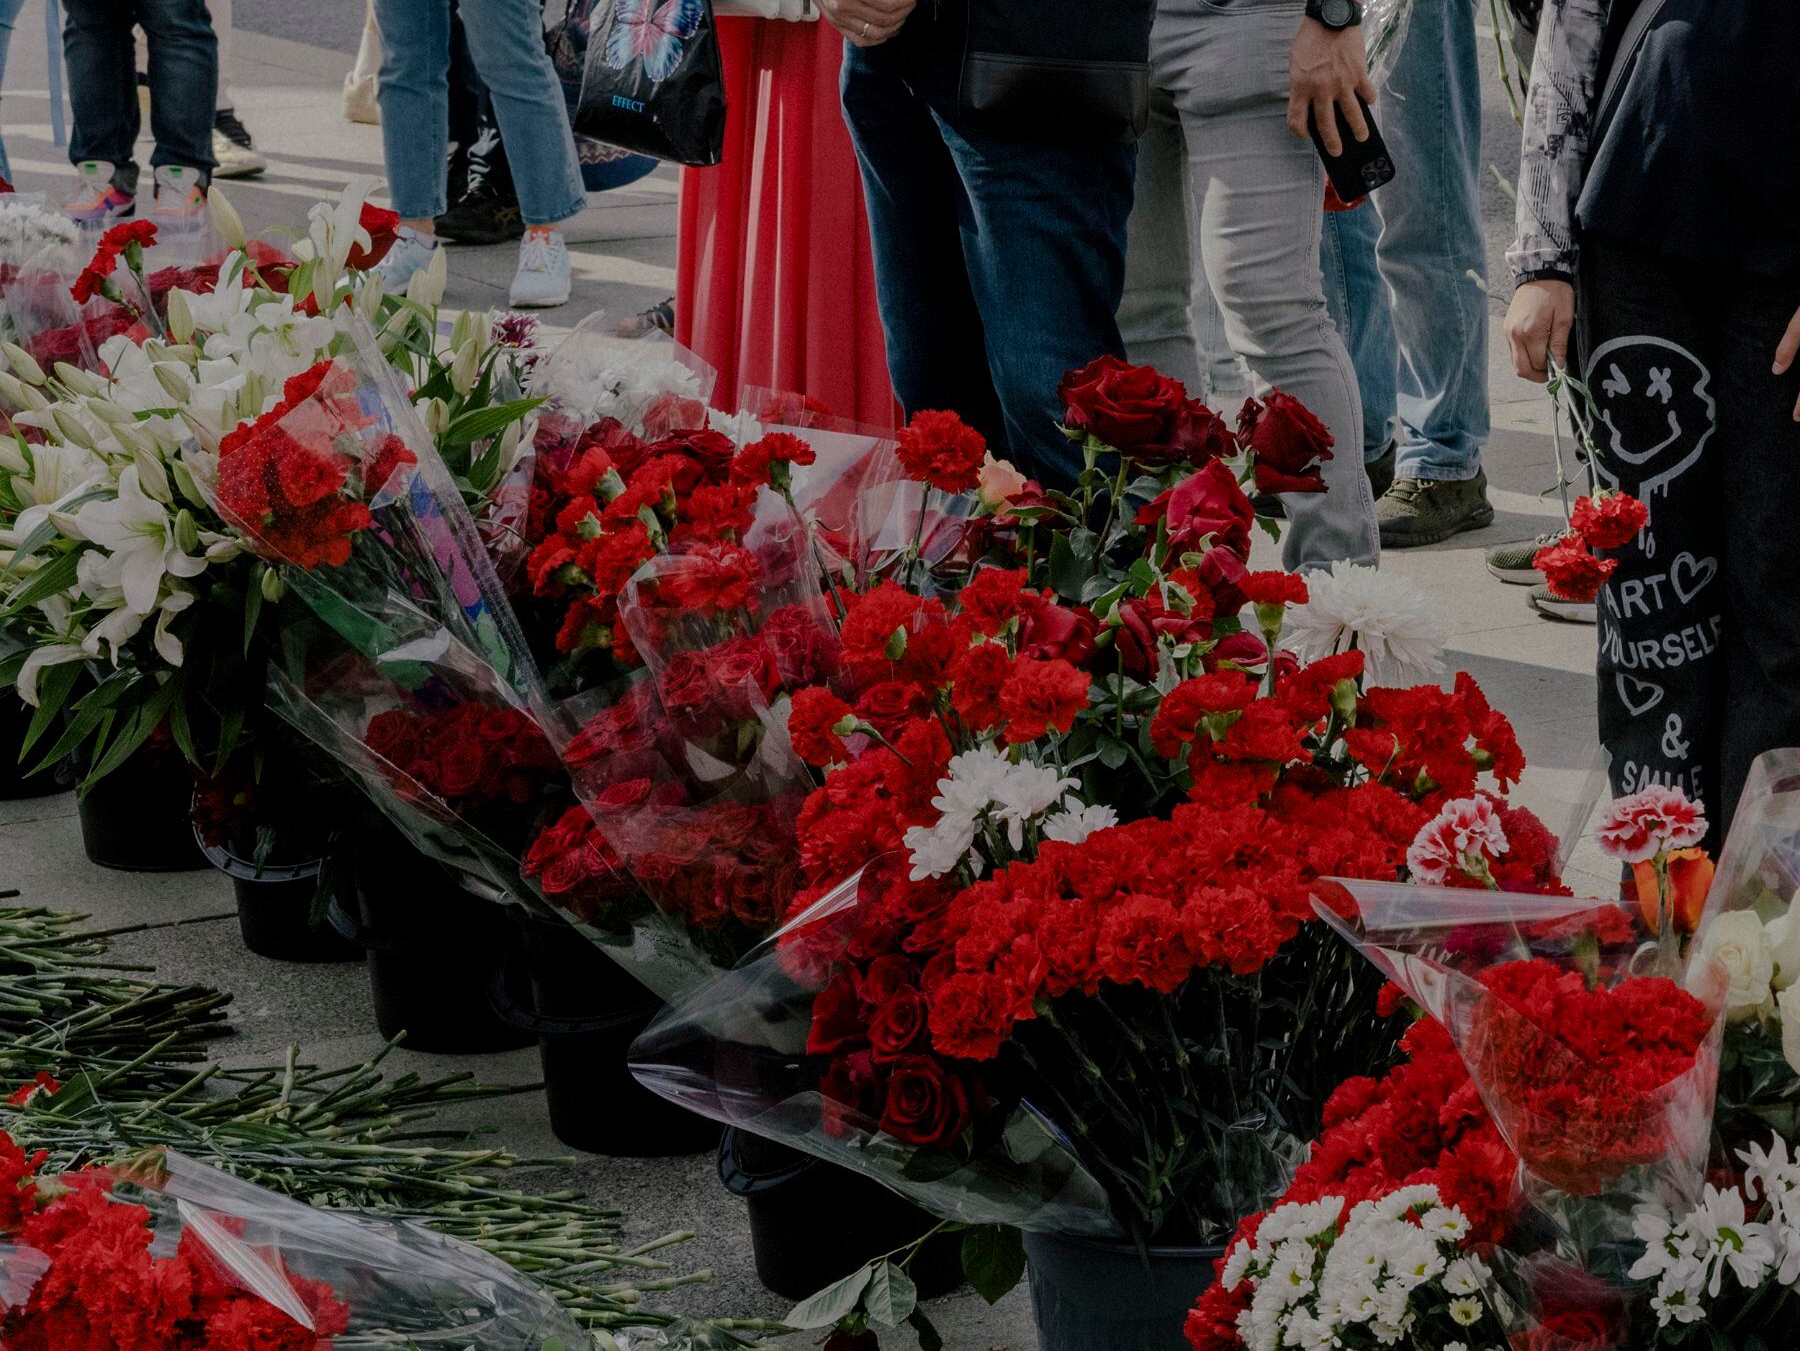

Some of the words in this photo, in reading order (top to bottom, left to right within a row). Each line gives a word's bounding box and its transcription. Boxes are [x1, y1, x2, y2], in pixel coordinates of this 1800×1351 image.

[612, 94, 645, 113] EFFECT
[1604, 573, 1667, 619] ART
[1601, 614, 1722, 669] YOURSELF
[1661, 712, 1690, 761] &
